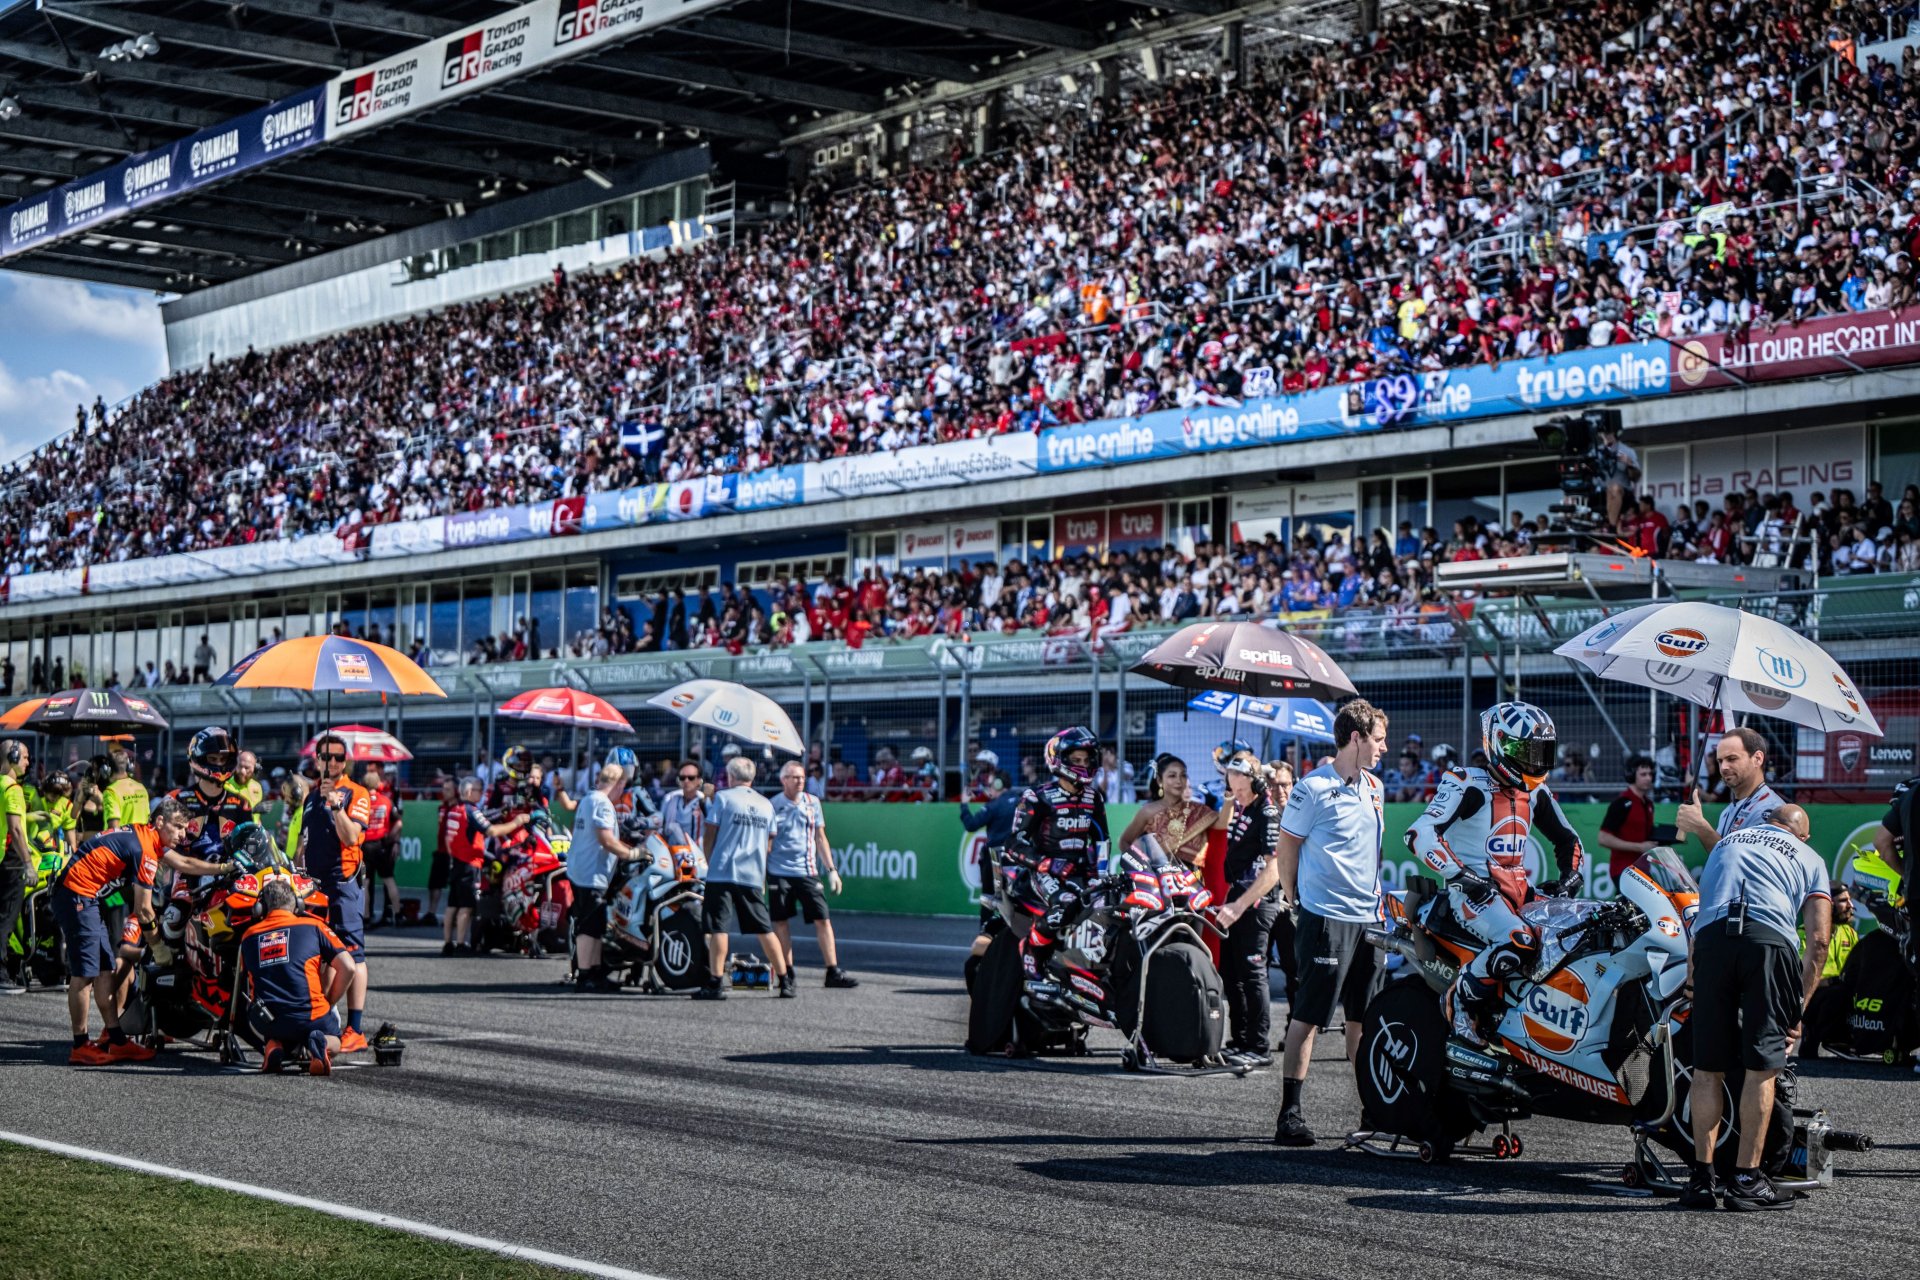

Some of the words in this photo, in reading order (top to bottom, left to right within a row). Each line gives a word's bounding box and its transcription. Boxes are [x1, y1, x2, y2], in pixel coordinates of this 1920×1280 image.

[487, 17, 530, 41] TOYOTA
[600, 6, 643, 30] Racing
[484, 34, 525, 57] GAZOO
[378, 59, 417, 81] TOYOTA
[482, 52, 522, 74] Racing
[375, 76, 412, 97] GAZOO
[373, 92, 411, 112] Racing
[275, 100, 314, 139] YAMAHA
[201, 129, 239, 165] YAMAHA
[265, 129, 311, 152] RACING
[134, 154, 170, 190] YAMAHA
[193, 158, 236, 178] RACING
[74, 181, 105, 213] YAMAHA
[127, 182, 168, 202] RACING
[19, 201, 48, 232] YAMAHA
[68, 207, 103, 225] RACING
[13, 226, 46, 244] RACING
[1761, 337, 1803, 361] OUR
[1517, 364, 1586, 403] true
[1588, 353, 1667, 396] online
[1183, 417, 1235, 449] true
[1236, 405, 1299, 441] online
[1047, 433, 1096, 466] true
[1099, 423, 1154, 459] online
[755, 474, 796, 504] online
[1634, 473, 1724, 500] onda
[1732, 460, 1854, 492] RACING
[447, 519, 476, 545] true
[477, 513, 510, 540] online
[966, 528, 994, 543] DUCATI
[1066, 519, 1098, 539] true
[1120, 514, 1154, 535] true
[917, 534, 944, 548] DUCATI
[1657, 634, 1708, 651] Gulf
[1239, 649, 1293, 666] aprilia
[1195, 665, 1246, 683] aprilia
[1870, 745, 1913, 760] Lenovo
[1057, 815, 1091, 830] aprilia
[825, 842, 917, 880] axnitron
[1426, 850, 1447, 870] Gulf
[1763, 841, 1795, 860] TEAM
[1625, 869, 1656, 892] TRACKHOUSE
[1528, 986, 1586, 1036] Gulf
[1455, 1051, 1493, 1069] MICHELIN
[1470, 1071, 1491, 1081] SC
[1519, 1048, 1619, 1102] TRACKHOUSE
